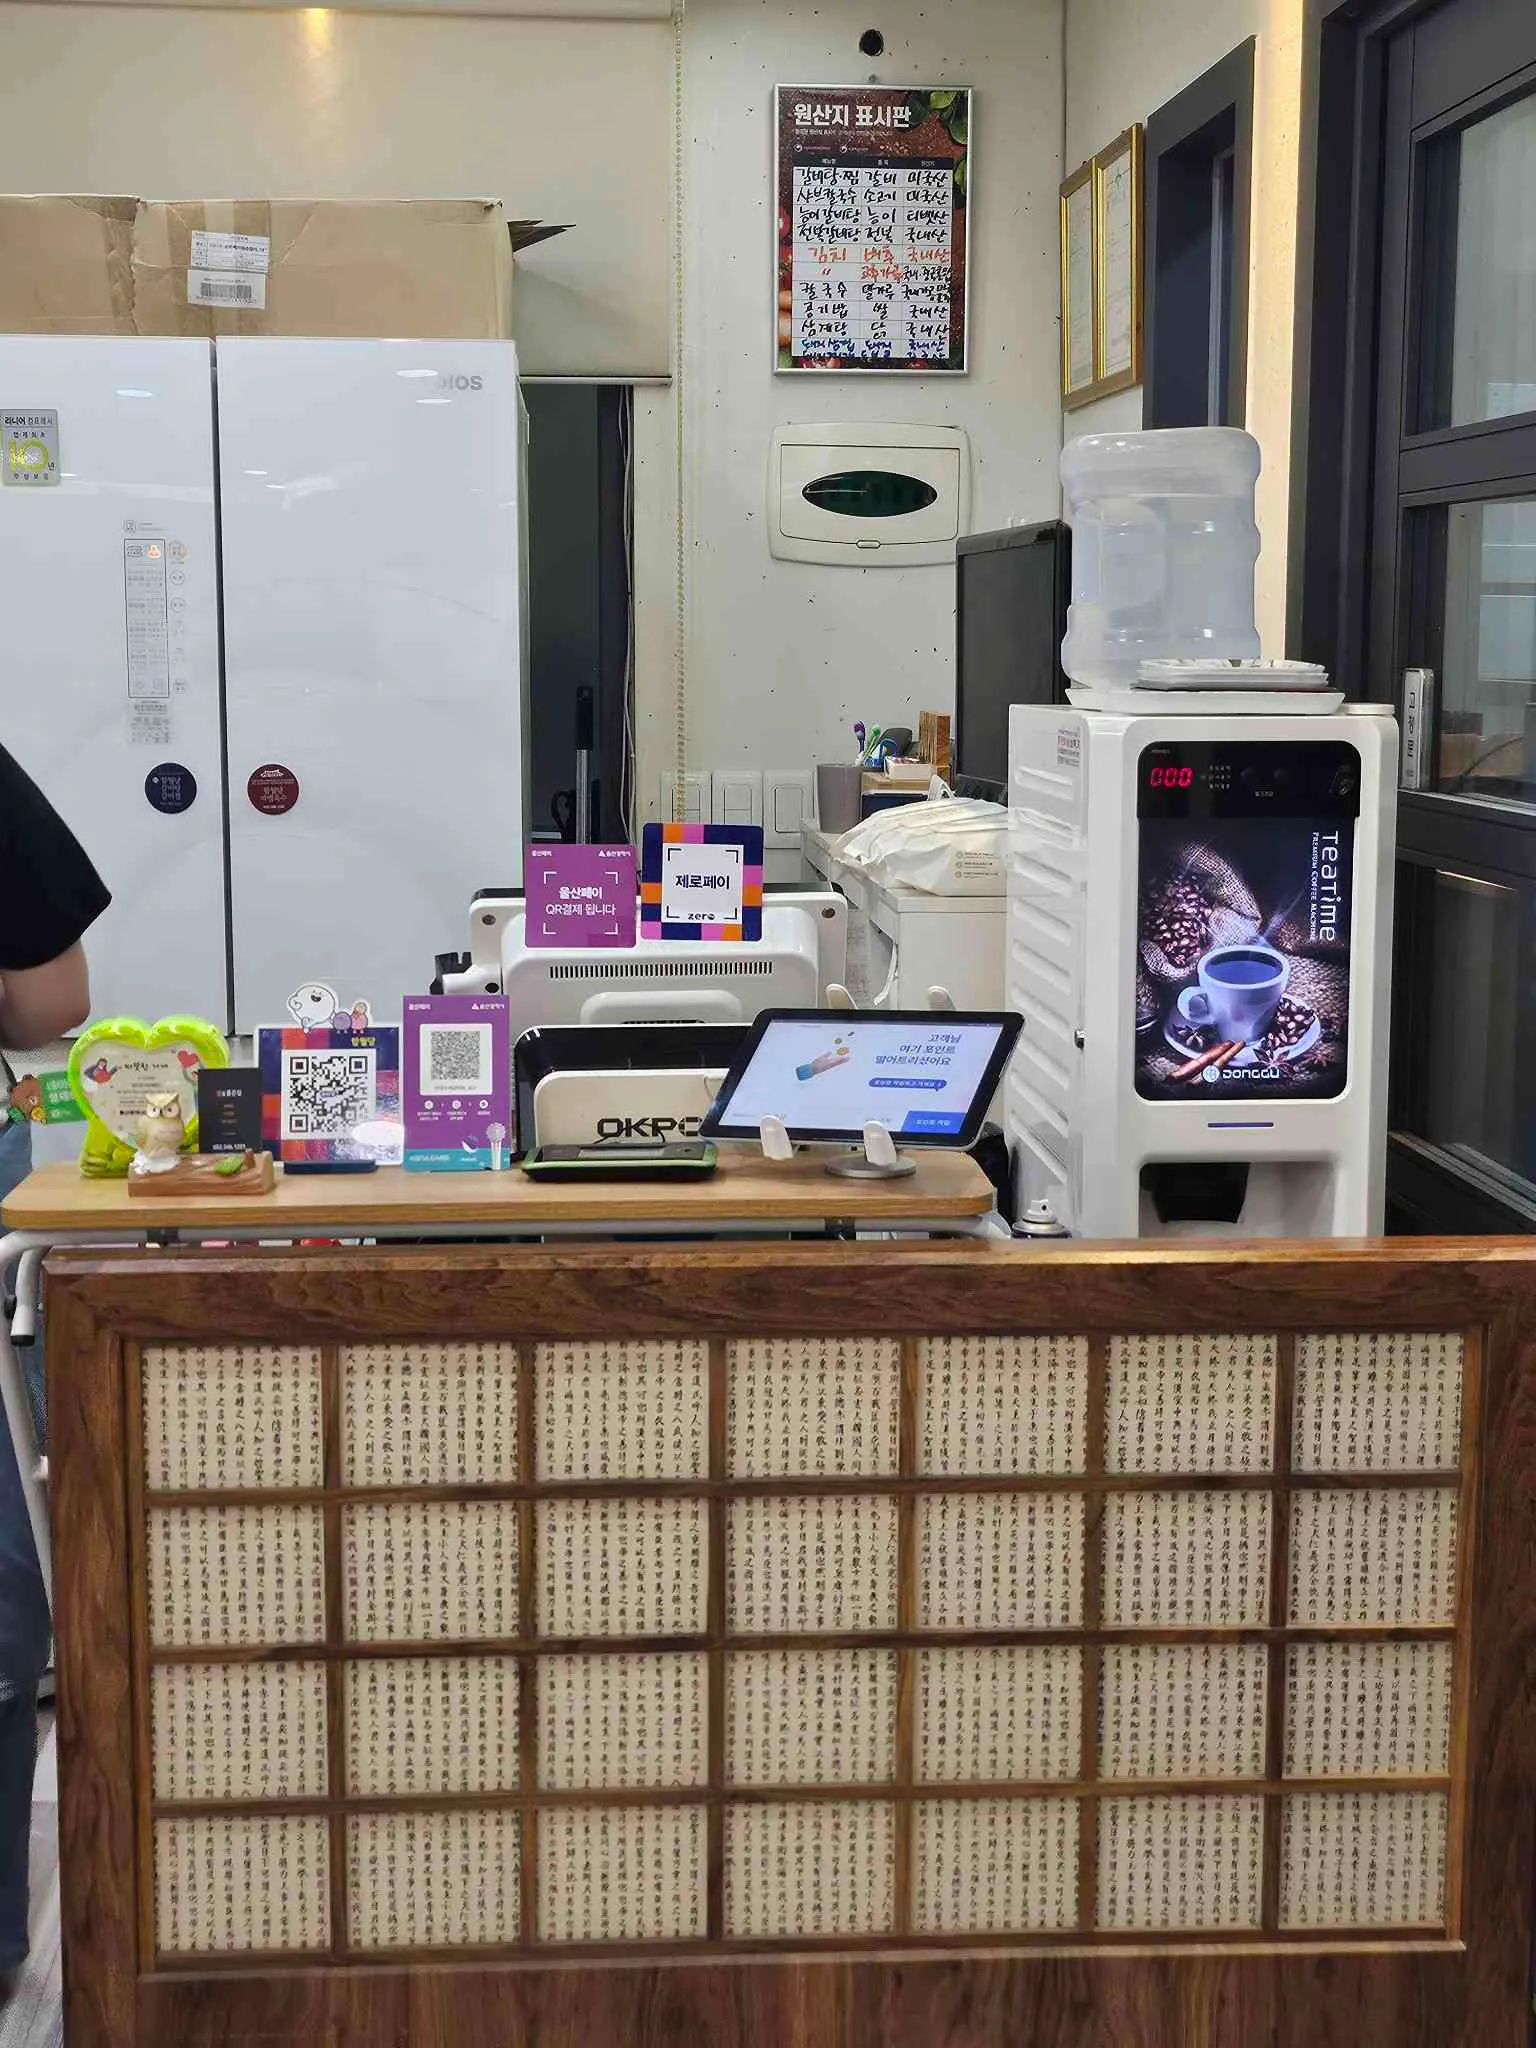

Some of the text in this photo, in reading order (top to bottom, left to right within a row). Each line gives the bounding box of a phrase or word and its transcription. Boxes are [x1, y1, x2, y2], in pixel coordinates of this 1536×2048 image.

[794, 103, 912, 128] 원산지 표시판
[865, 171, 897, 187] 갈비
[907, 171, 950, 188] 미국산
[863, 188, 897, 203] 소고기
[906, 189, 950, 206] 미국산
[864, 225, 893, 244] 전복
[904, 227, 949, 244] 국내산
[872, 302, 889, 321] 쌀
[675, 875, 730, 890] 제로페이
[559, 886, 603, 900] 울산페이
[545, 903, 618, 917] QR결제 됩니다
[687, 912, 716, 922] zero
